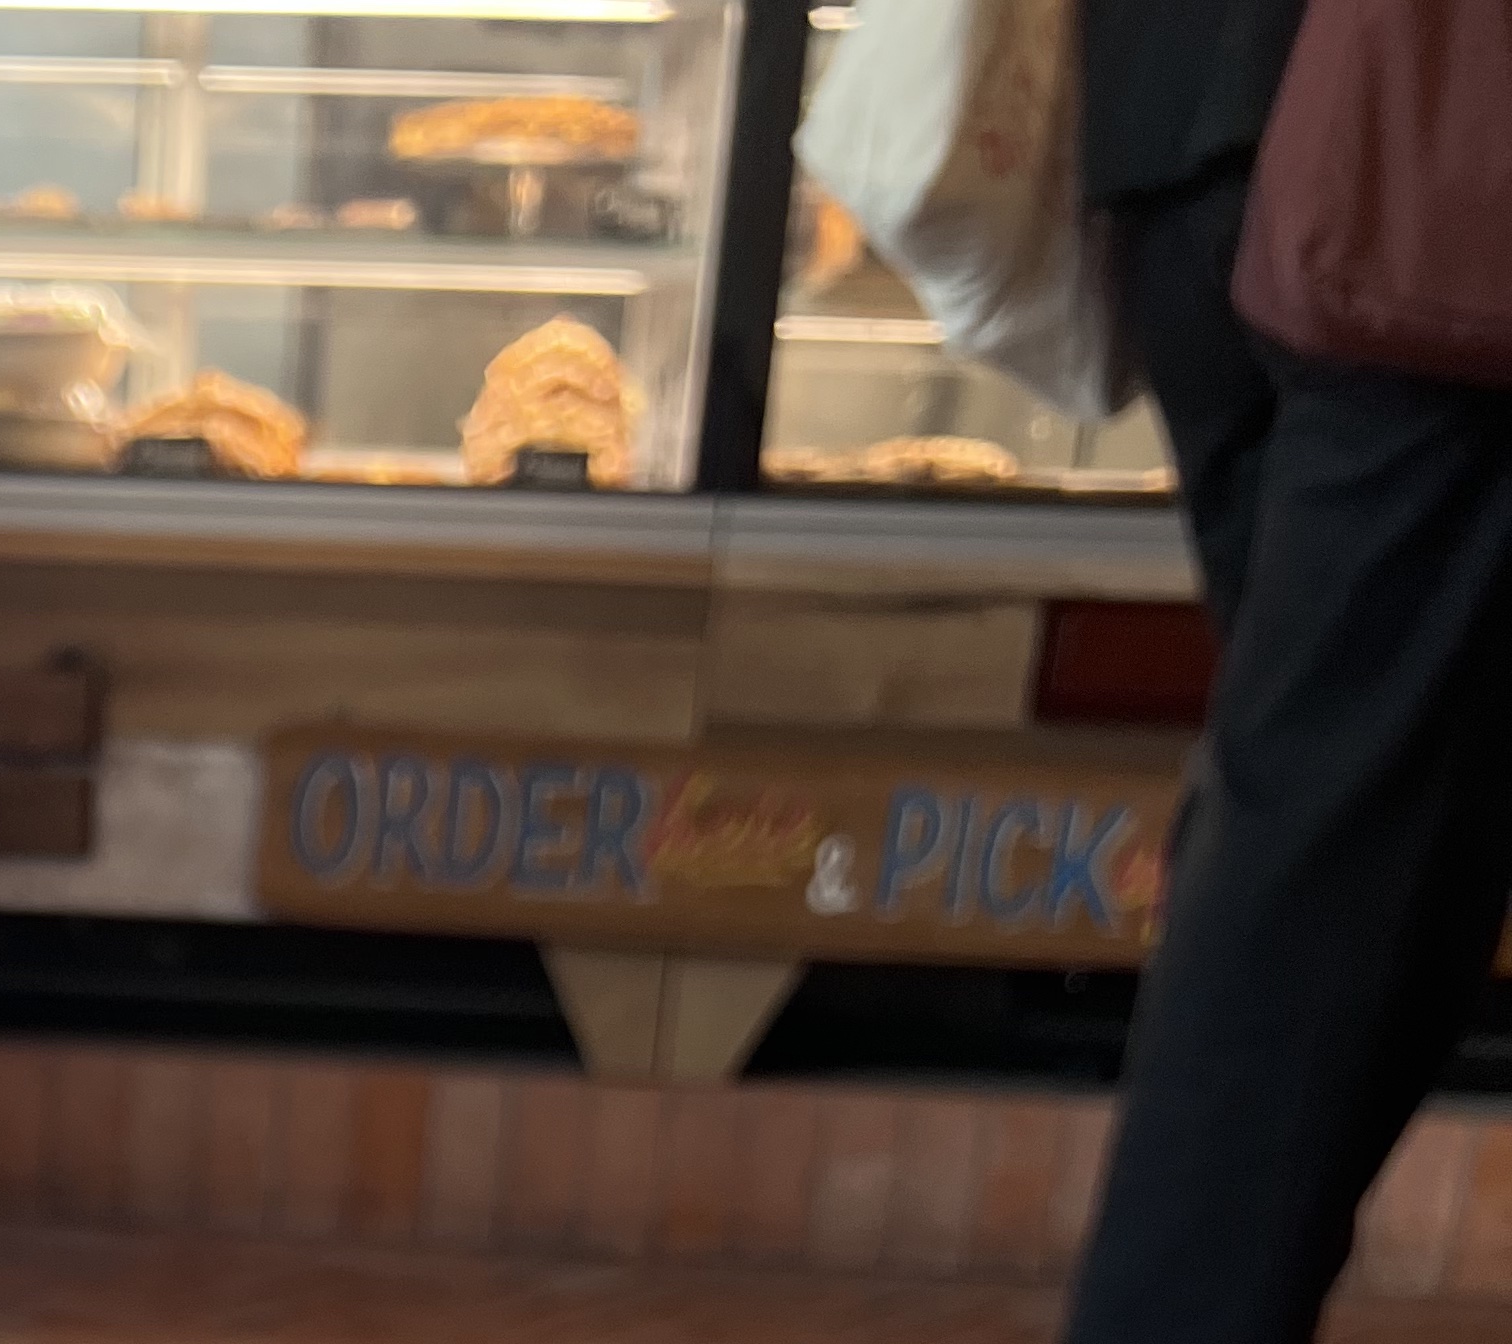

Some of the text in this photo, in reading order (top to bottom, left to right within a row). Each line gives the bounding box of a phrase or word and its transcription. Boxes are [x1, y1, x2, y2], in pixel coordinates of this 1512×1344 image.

[292, 750, 660, 900] ORDER
[806, 834, 857, 914] &
[875, 782, 1126, 935] PICK
